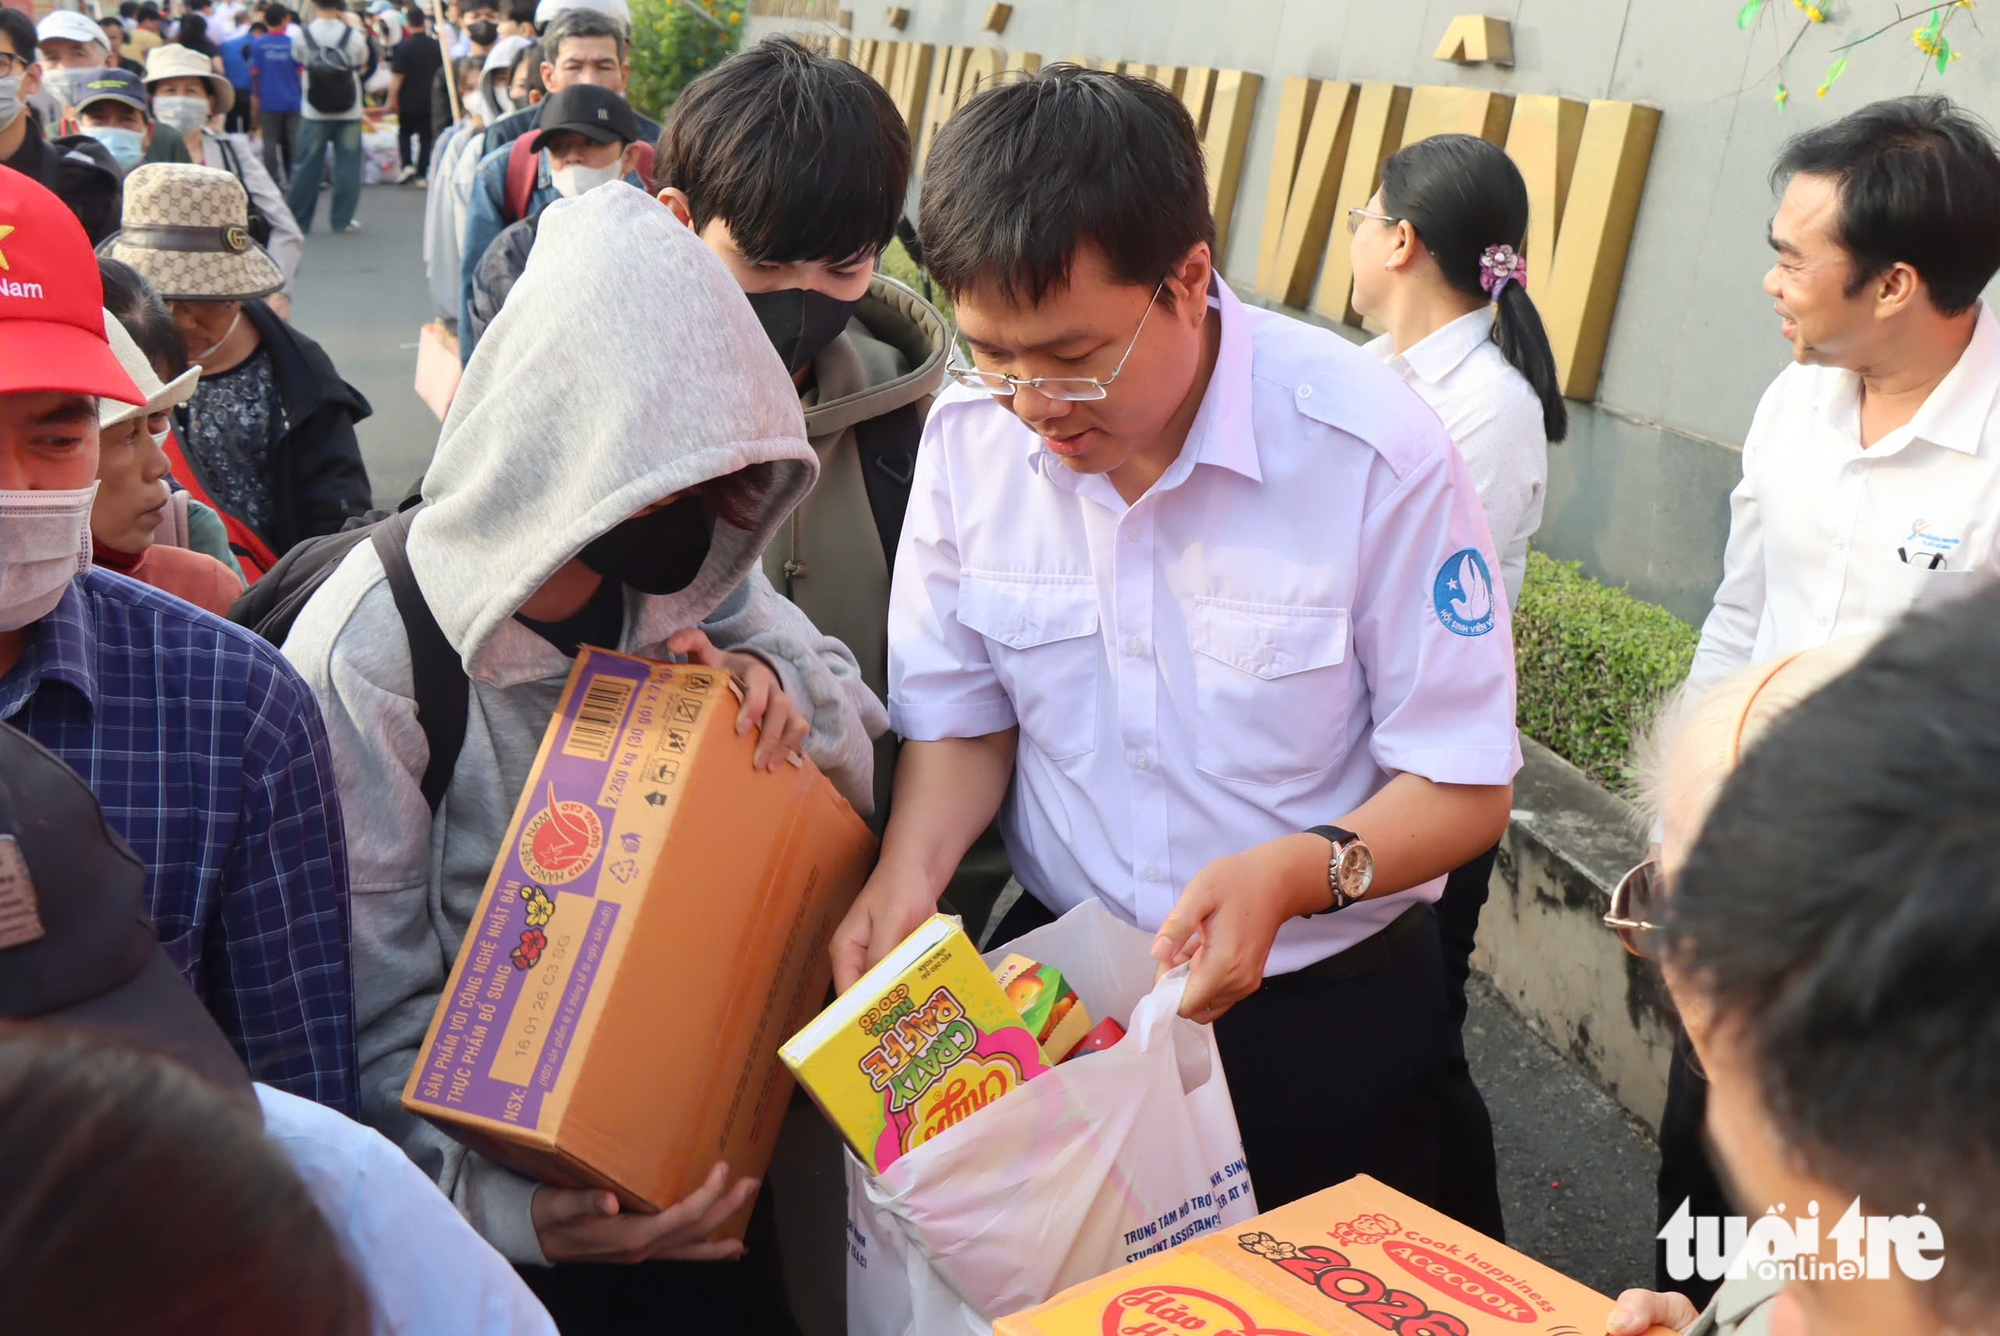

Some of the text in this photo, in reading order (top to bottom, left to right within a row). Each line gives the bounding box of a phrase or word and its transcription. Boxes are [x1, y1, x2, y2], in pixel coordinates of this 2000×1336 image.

[1254, 14, 1662, 401] VIN
[1450, 621, 1468, 633] SINH
[1470, 622, 1489, 633] VIÊN
[626, 728, 644, 748] (30
[638, 704, 654, 726] gói
[605, 769, 629, 805] 2,250
[621, 752, 638, 767] kg
[520, 811, 565, 886] HÀNG VIỆT NAM
[425, 879, 521, 1099] SẢN PHẨM VỚI CÔNG NGHỆ NHẬT BẢN
[514, 1039, 531, 1057] 16
[524, 1016, 539, 1034] 01
[542, 964, 560, 986] C3
[446, 964, 512, 1103] THỰC PHẨM BỔ SUNG
[861, 988, 963, 1089] RAFFE
[890, 1019, 976, 1110] CRAZY
[503, 1088, 528, 1122] NSX:
[1124, 1221, 1157, 1246] TRUNG
[1157, 1209, 1178, 1230] TÂM
[1190, 1191, 1213, 1211] TRỢ
[1227, 1186, 1241, 1202] AT
[1275, 1245, 1470, 1336] 2026
[1404, 1230, 1557, 1314] Cook happiness
[1122, 1291, 1206, 1330] Hảo
